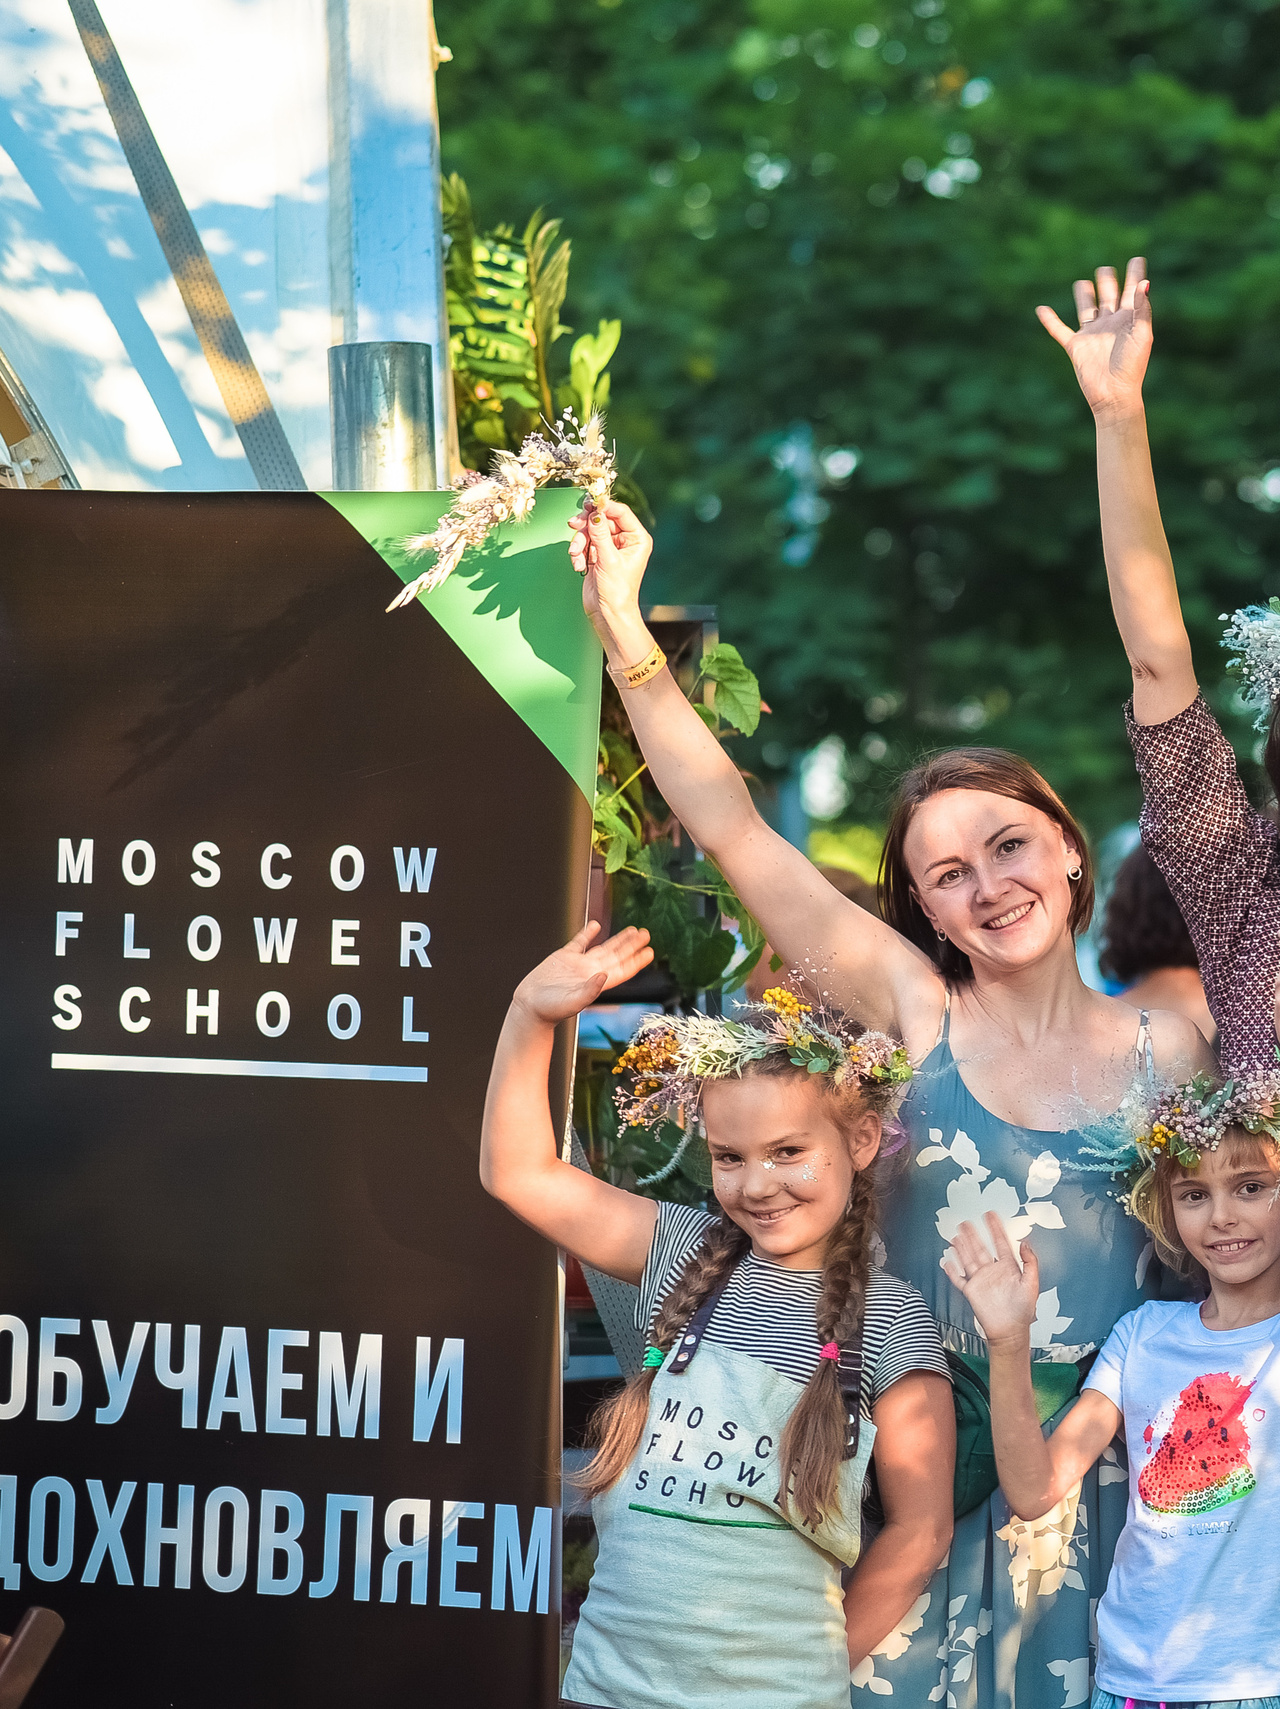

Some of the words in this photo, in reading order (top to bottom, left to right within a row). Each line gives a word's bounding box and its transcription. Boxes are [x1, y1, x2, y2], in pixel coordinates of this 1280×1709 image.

[57, 838, 437, 893] MOSCOW
[55, 911, 432, 968] FLOWER
[51, 984, 430, 1042] SCHOOL
[412, 1336, 464, 1444] И
[659, 1398, 800, 1478] MOSC
[635, 1469, 745, 1509] SCHO
